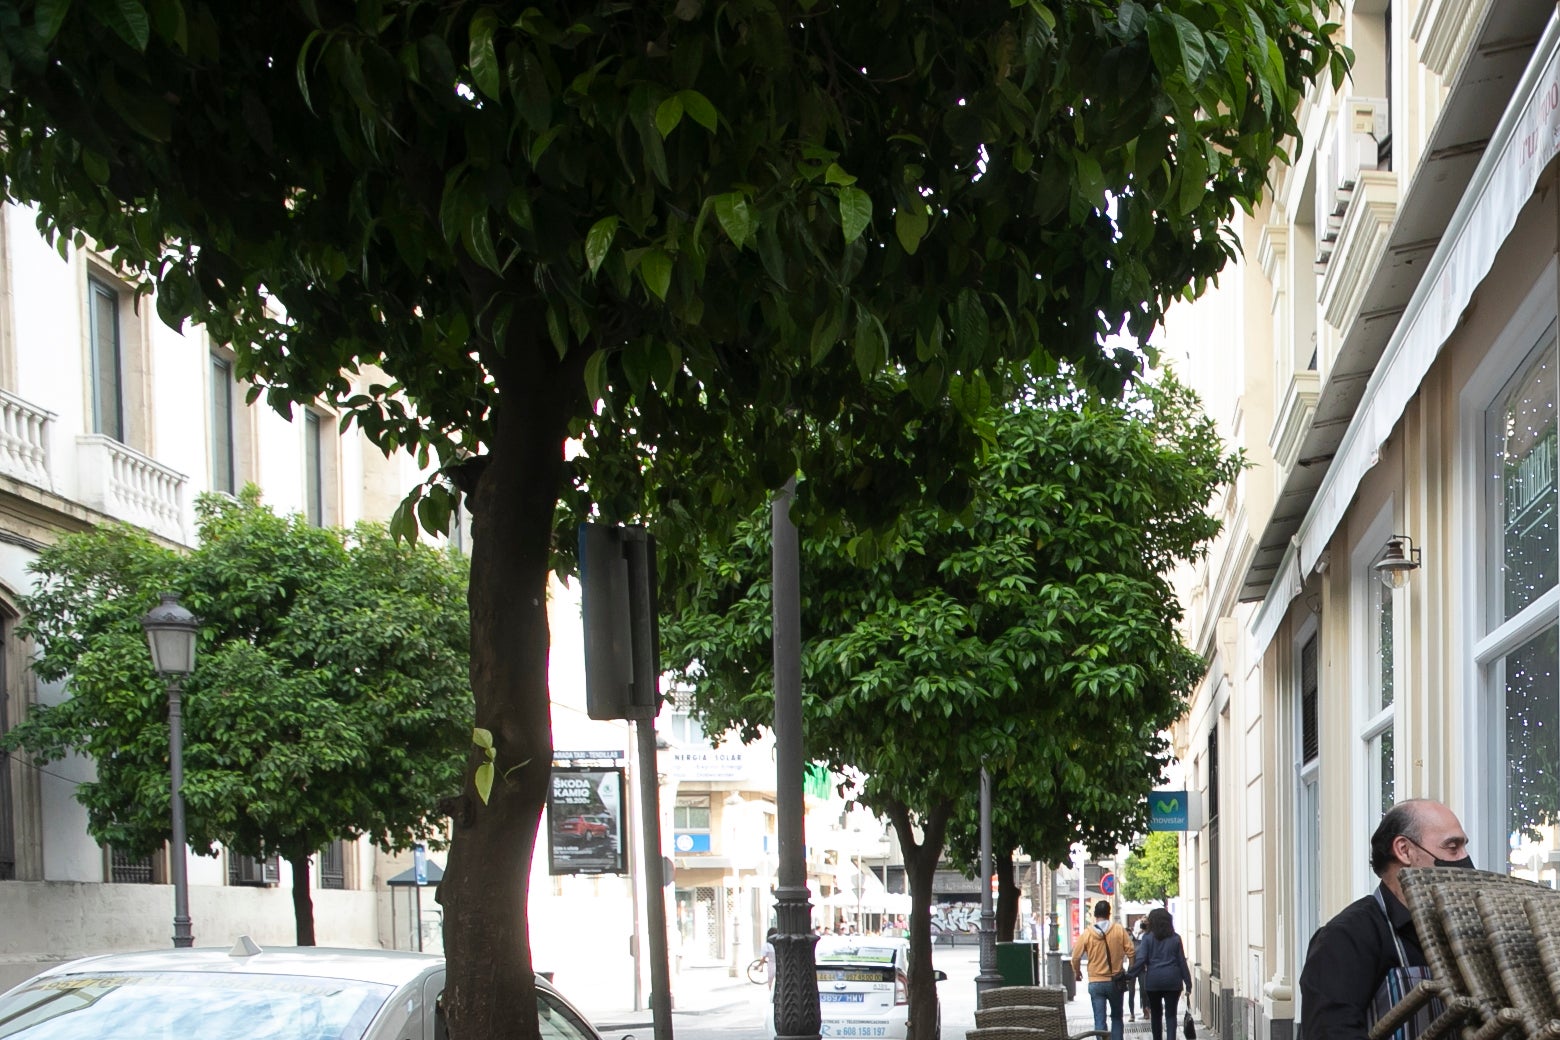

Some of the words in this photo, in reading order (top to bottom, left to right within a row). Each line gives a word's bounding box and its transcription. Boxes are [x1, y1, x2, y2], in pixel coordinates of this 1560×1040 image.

[553, 751, 574, 759] ARADA
[553, 778, 591, 788] ŠKODA
[553, 788, 590, 798] KAMIQ
[1151, 817, 1185, 826] movistar
[843, 1026, 856, 1036] 608
[858, 1026, 872, 1036] 158
[873, 1026, 886, 1036] 197
